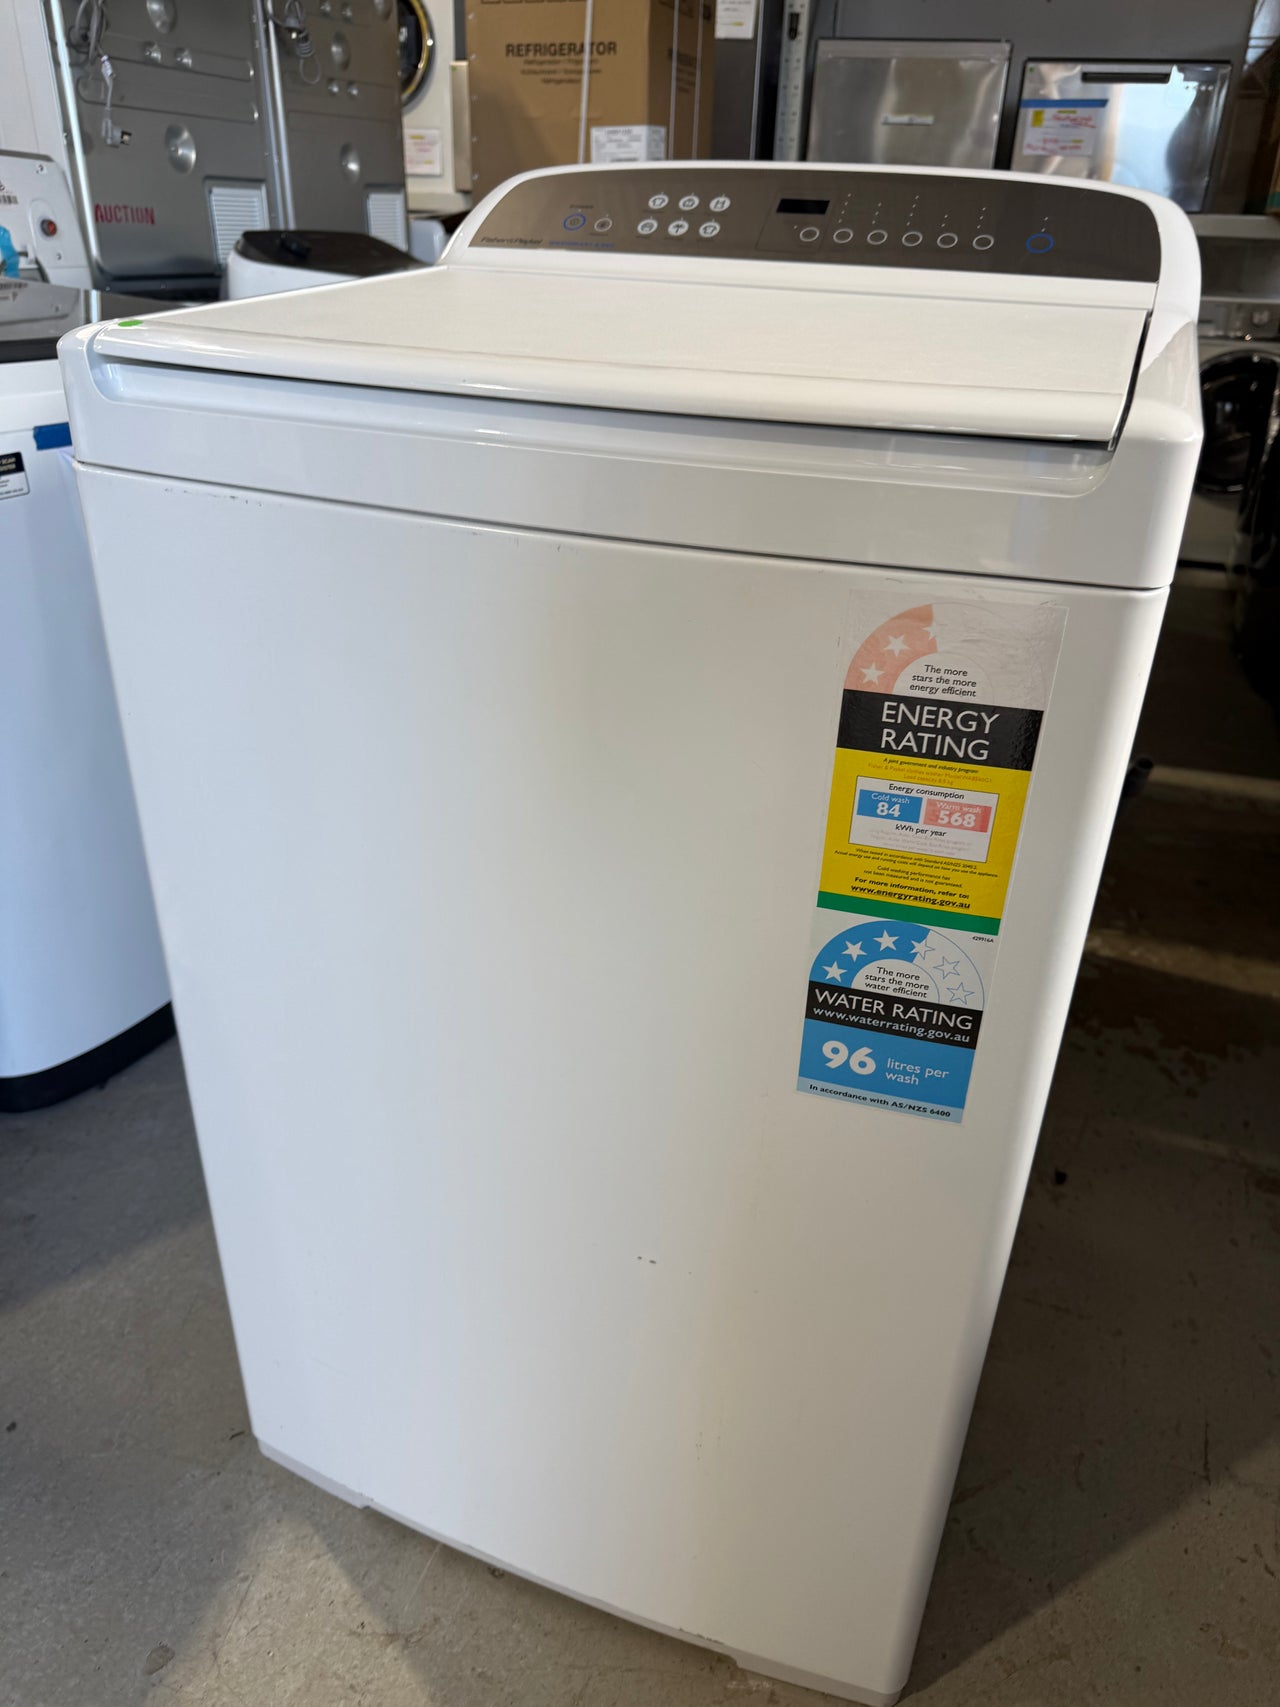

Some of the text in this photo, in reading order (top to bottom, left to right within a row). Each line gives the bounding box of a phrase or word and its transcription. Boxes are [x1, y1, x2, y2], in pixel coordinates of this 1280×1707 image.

[924, 664, 968, 677] The more
[912, 674, 977, 688] stars the more
[909, 683, 977, 697] energy efficient
[881, 701, 1000, 734] ENERGY
[880, 728, 990, 761] RATING
[899, 760, 927, 769] government
[938, 764, 957, 772] industry
[871, 792, 910, 804] Cold wash
[889, 784, 965, 800] Energy consumption
[876, 802, 901, 818] 84
[935, 802, 982, 814] Warm wash
[938, 811, 976, 827] 568
[895, 824, 947, 837] kWh per year
[910, 870, 942, 880] performance
[851, 885, 971, 909] www.energyrating.gov.au
[889, 881, 936, 895] information,
[938, 889, 957, 898] refer
[958, 892, 970, 900] to:
[876, 966, 920, 981] The more
[864, 974, 930, 991] stars the more
[864, 982, 928, 999] water efficient
[814, 988, 973, 1030] WATER RATING
[813, 1007, 970, 1043] www.waterrating.gov.au
[822, 1040, 949, 1079] 96 litres per
[885, 1071, 919, 1085] wash
[820, 1086, 867, 1101] accordance
[869, 1096, 889, 1106] with
[892, 1101, 927, 1113] AS/NZS
[929, 1108, 951, 1118] 6400
